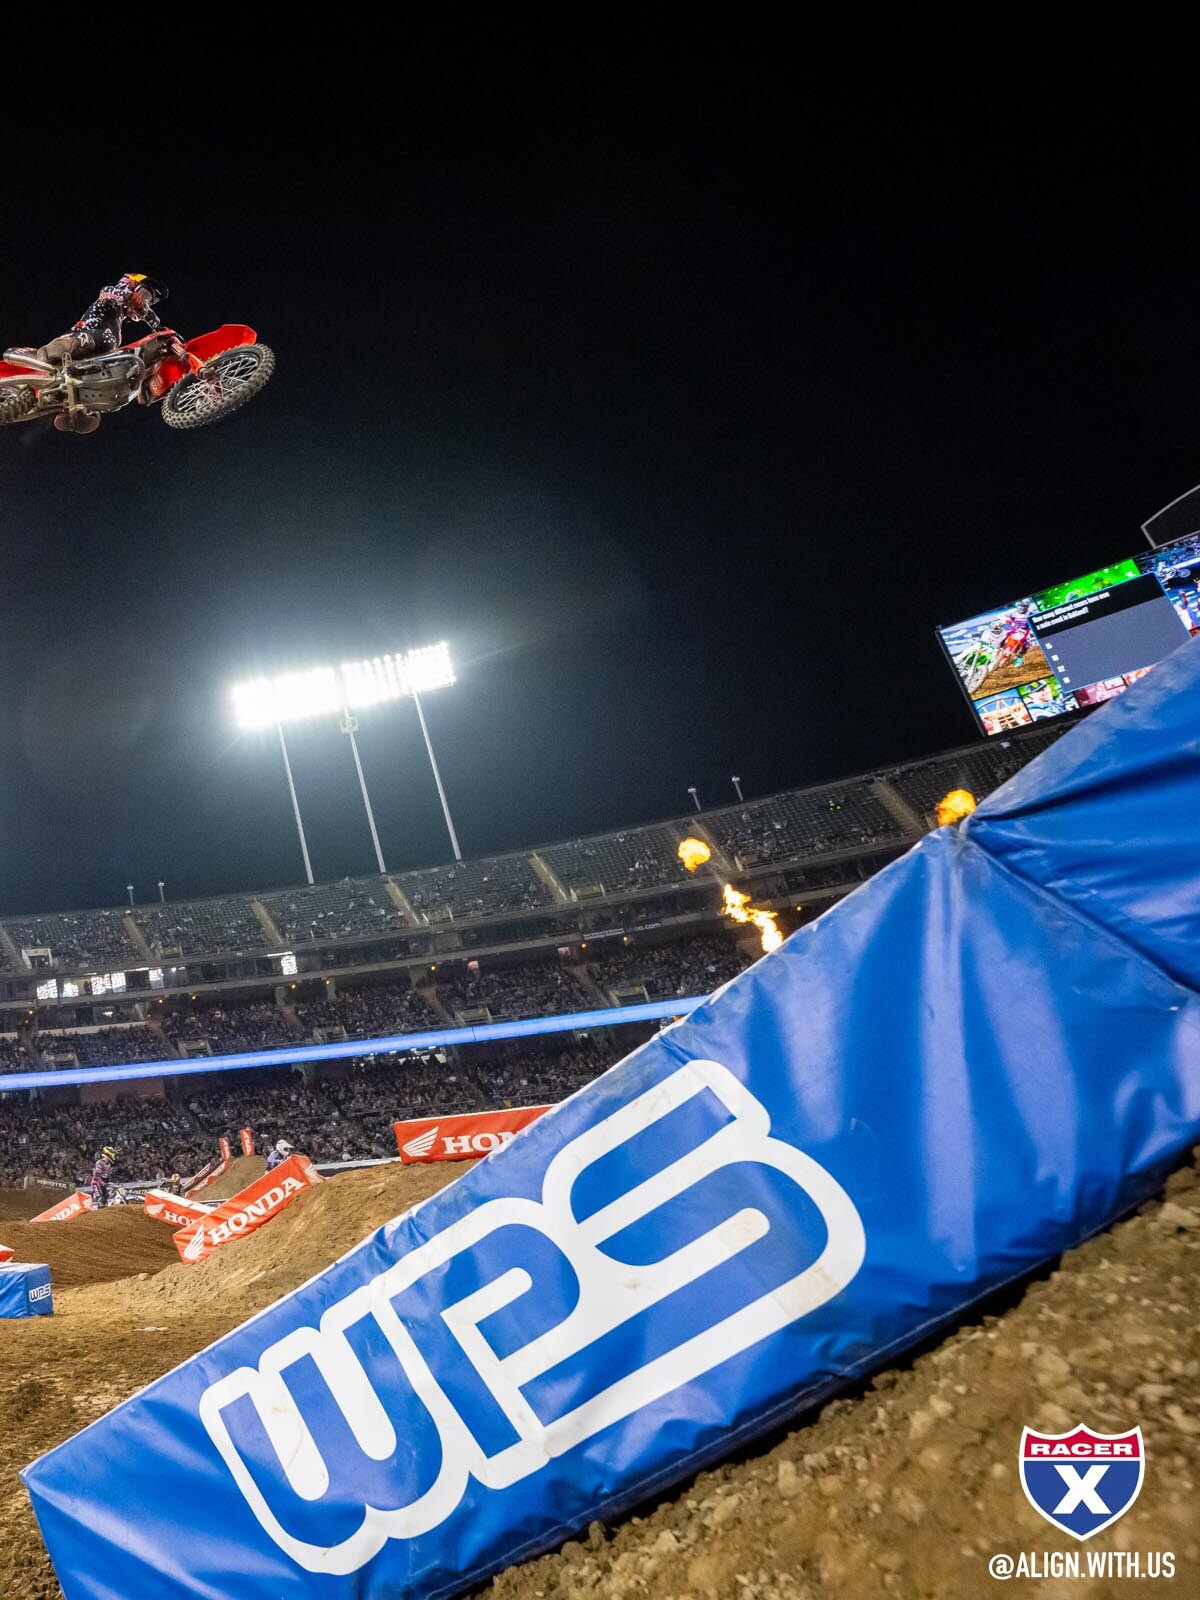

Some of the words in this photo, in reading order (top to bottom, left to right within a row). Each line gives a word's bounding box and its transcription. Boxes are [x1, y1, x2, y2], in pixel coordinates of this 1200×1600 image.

[48, 1203, 81, 1221] NDA
[207, 1176, 307, 1246] HONDA
[28, 1283, 51, 1303] WPS
[198, 1059, 867, 1576] WPS
